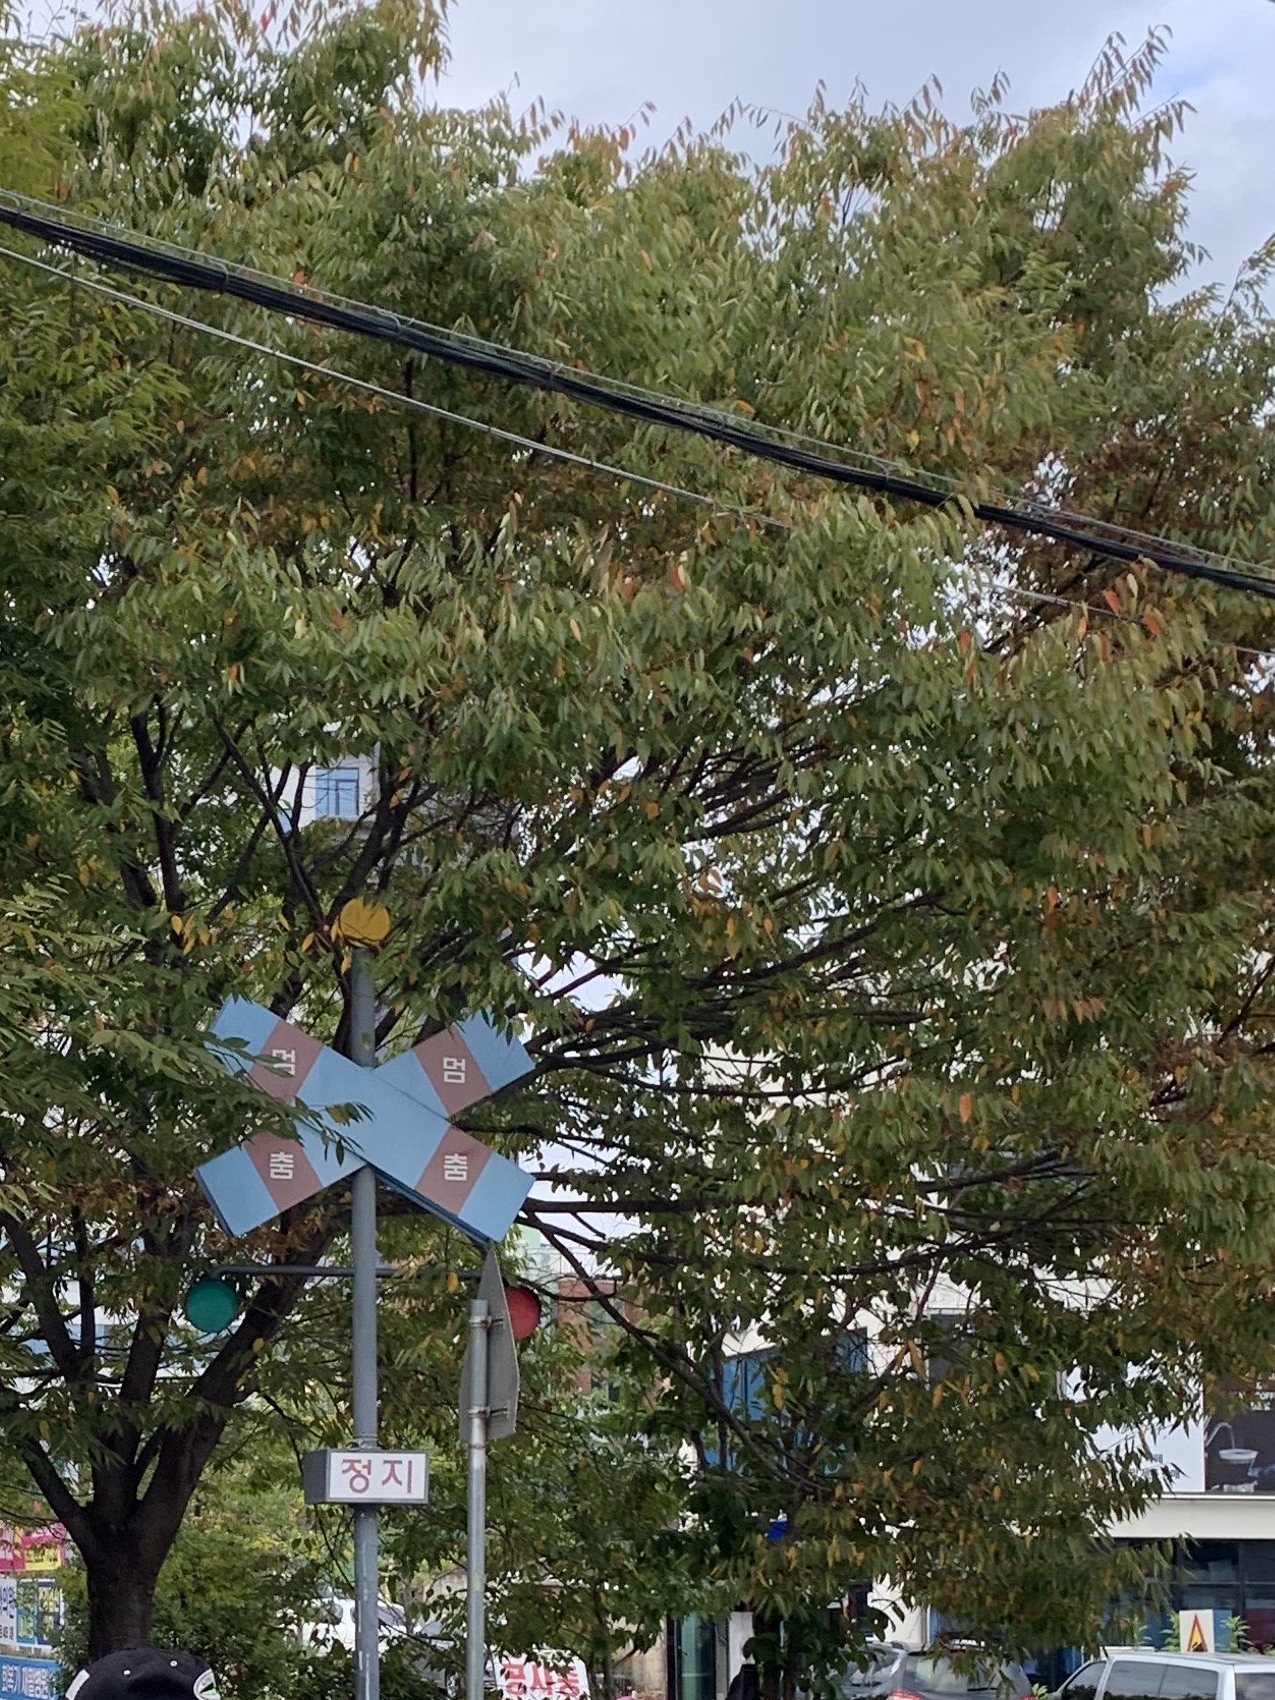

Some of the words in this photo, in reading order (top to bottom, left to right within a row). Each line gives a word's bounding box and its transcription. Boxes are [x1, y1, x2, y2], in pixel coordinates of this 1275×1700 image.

[443, 1057, 466, 1083] 멈
[269, 1151, 294, 1179] 춤
[444, 1153, 468, 1181] 춤
[342, 1458, 413, 1494] 정지
